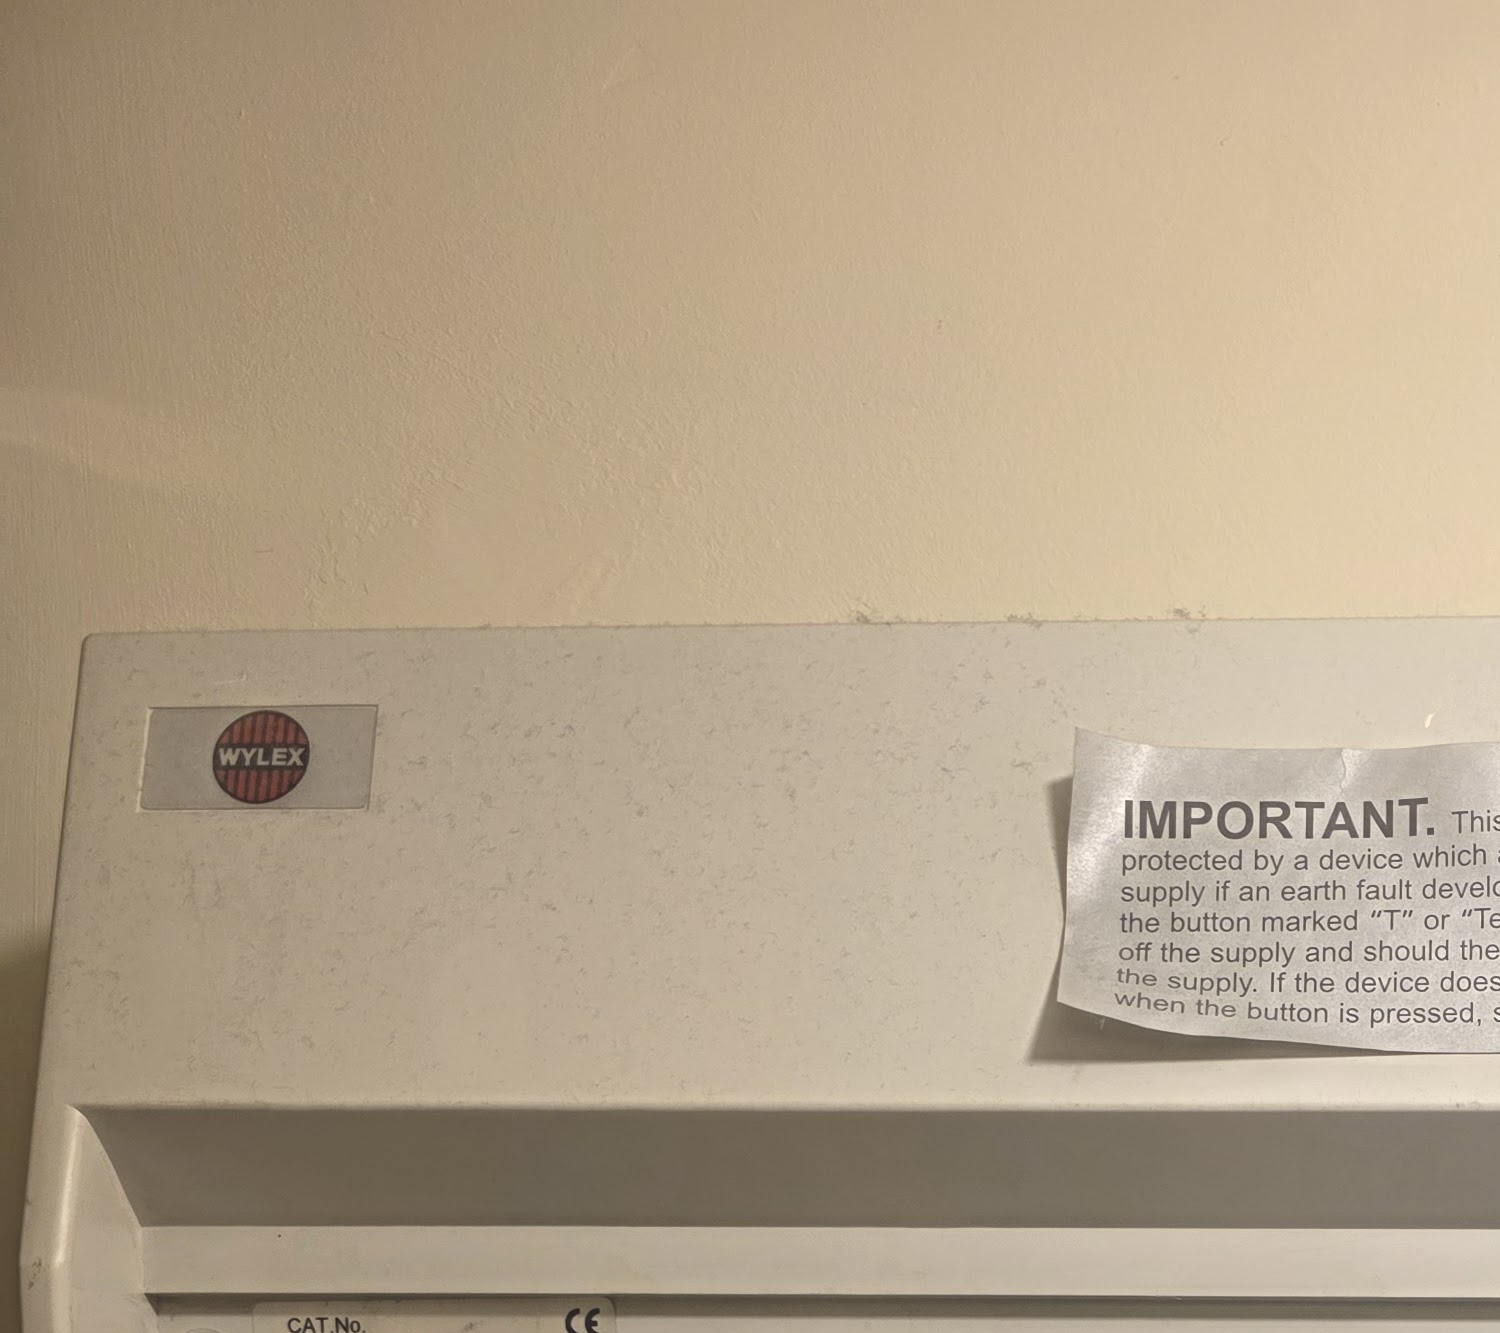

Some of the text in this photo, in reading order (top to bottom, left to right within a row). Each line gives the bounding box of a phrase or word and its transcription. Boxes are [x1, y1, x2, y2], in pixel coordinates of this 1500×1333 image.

[218, 748, 305, 766] WYLEX
[1124, 797, 1435, 840] IMPORTANT.
[1121, 849, 1243, 876] protected
[1254, 849, 1284, 876] by
[1294, 854, 1309, 871] a
[1319, 848, 1403, 870] device
[1413, 843, 1487, 869] which
[1120, 880, 1205, 907] supply
[1215, 880, 1230, 902] if
[1238, 884, 1270, 902] an
[1281, 880, 1346, 902] earth
[1356, 878, 1413, 901] fault
